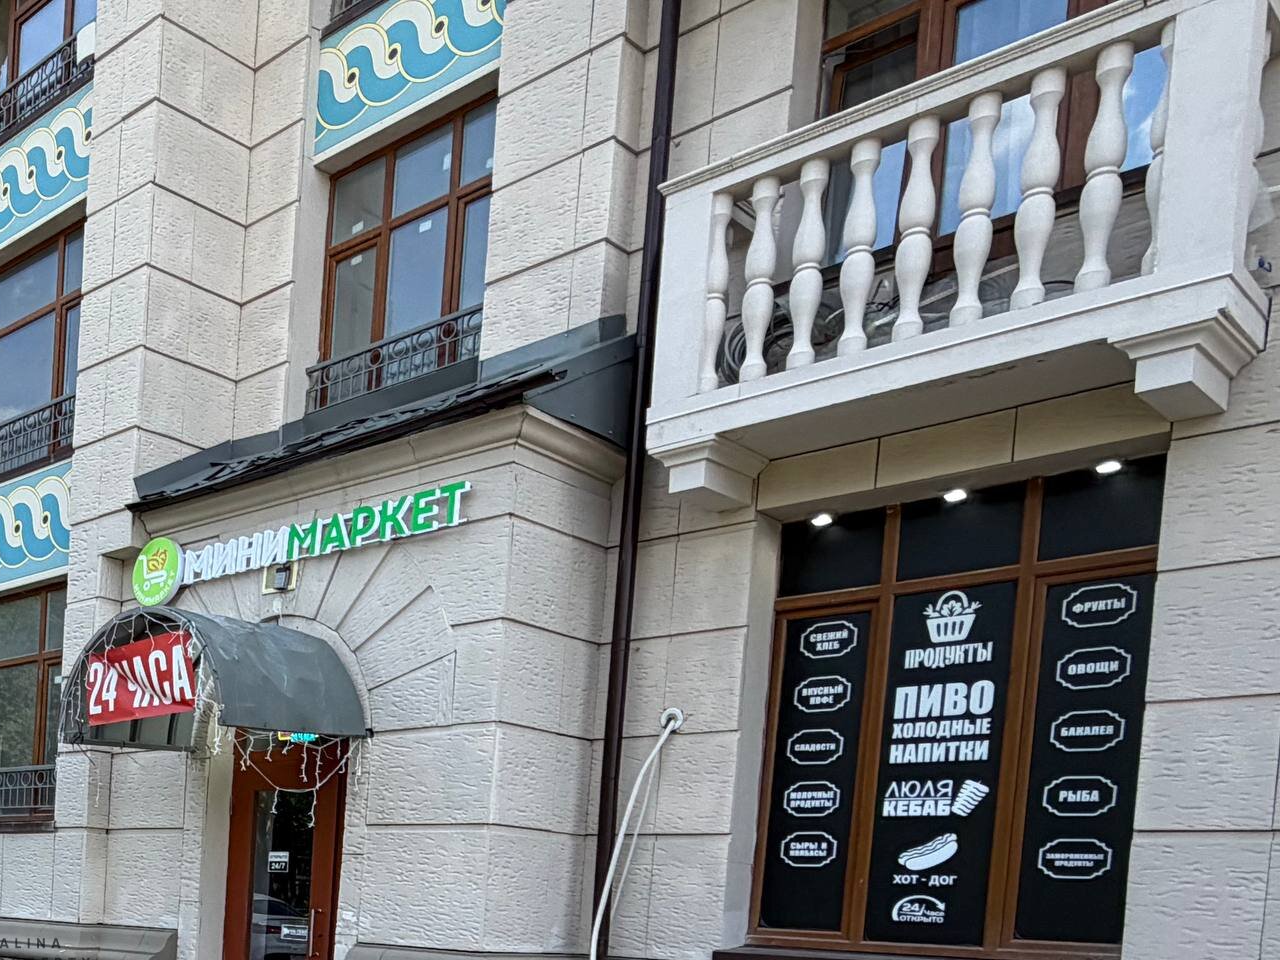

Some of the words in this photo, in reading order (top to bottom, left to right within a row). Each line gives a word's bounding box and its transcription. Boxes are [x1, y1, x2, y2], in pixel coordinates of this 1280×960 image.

[1072, 598, 1126, 613] ФРУКТЫ
[810, 629, 848, 642] СВЕЖИЙ
[816, 640, 840, 651] ХЛЕБ
[904, 641, 993, 669] ПРОДУКТЫ
[1067, 661, 1119, 675] ОВОЩИ
[89, 662, 119, 715] 24
[114, 645, 193, 708] ЧАСА
[802, 684, 844, 696] ВКУСНЫЙ
[809, 695, 834, 705] КОФЕ
[893, 680, 995, 719] ПИВО
[892, 718, 992, 739] ХОЛОДНЫЕ
[1060, 725, 1114, 737] БАКАЛЕЯ
[794, 743, 836, 752] СЛАДОСТИ
[889, 740, 989, 764] НАПИТКИ
[885, 779, 953, 797] ЛЮЛЯ
[790, 791, 834, 799] МОЛОЧНЫЕ
[1058, 790, 1100, 802] РЫБА
[790, 799, 833, 808] ПРОДУКТЫ
[882, 800, 951, 817] КЕБАБ
[790, 842, 818, 850] СЫРЫ
[820, 842, 827, 850] И
[271, 862, 287, 871] 24/7
[1054, 860, 1094, 868] ПРОДУКТЫ
[892, 874, 920, 885] ХОТ
[928, 874, 958, 887] ДОГ
[900, 915, 944, 923] ОТКРЫТО
